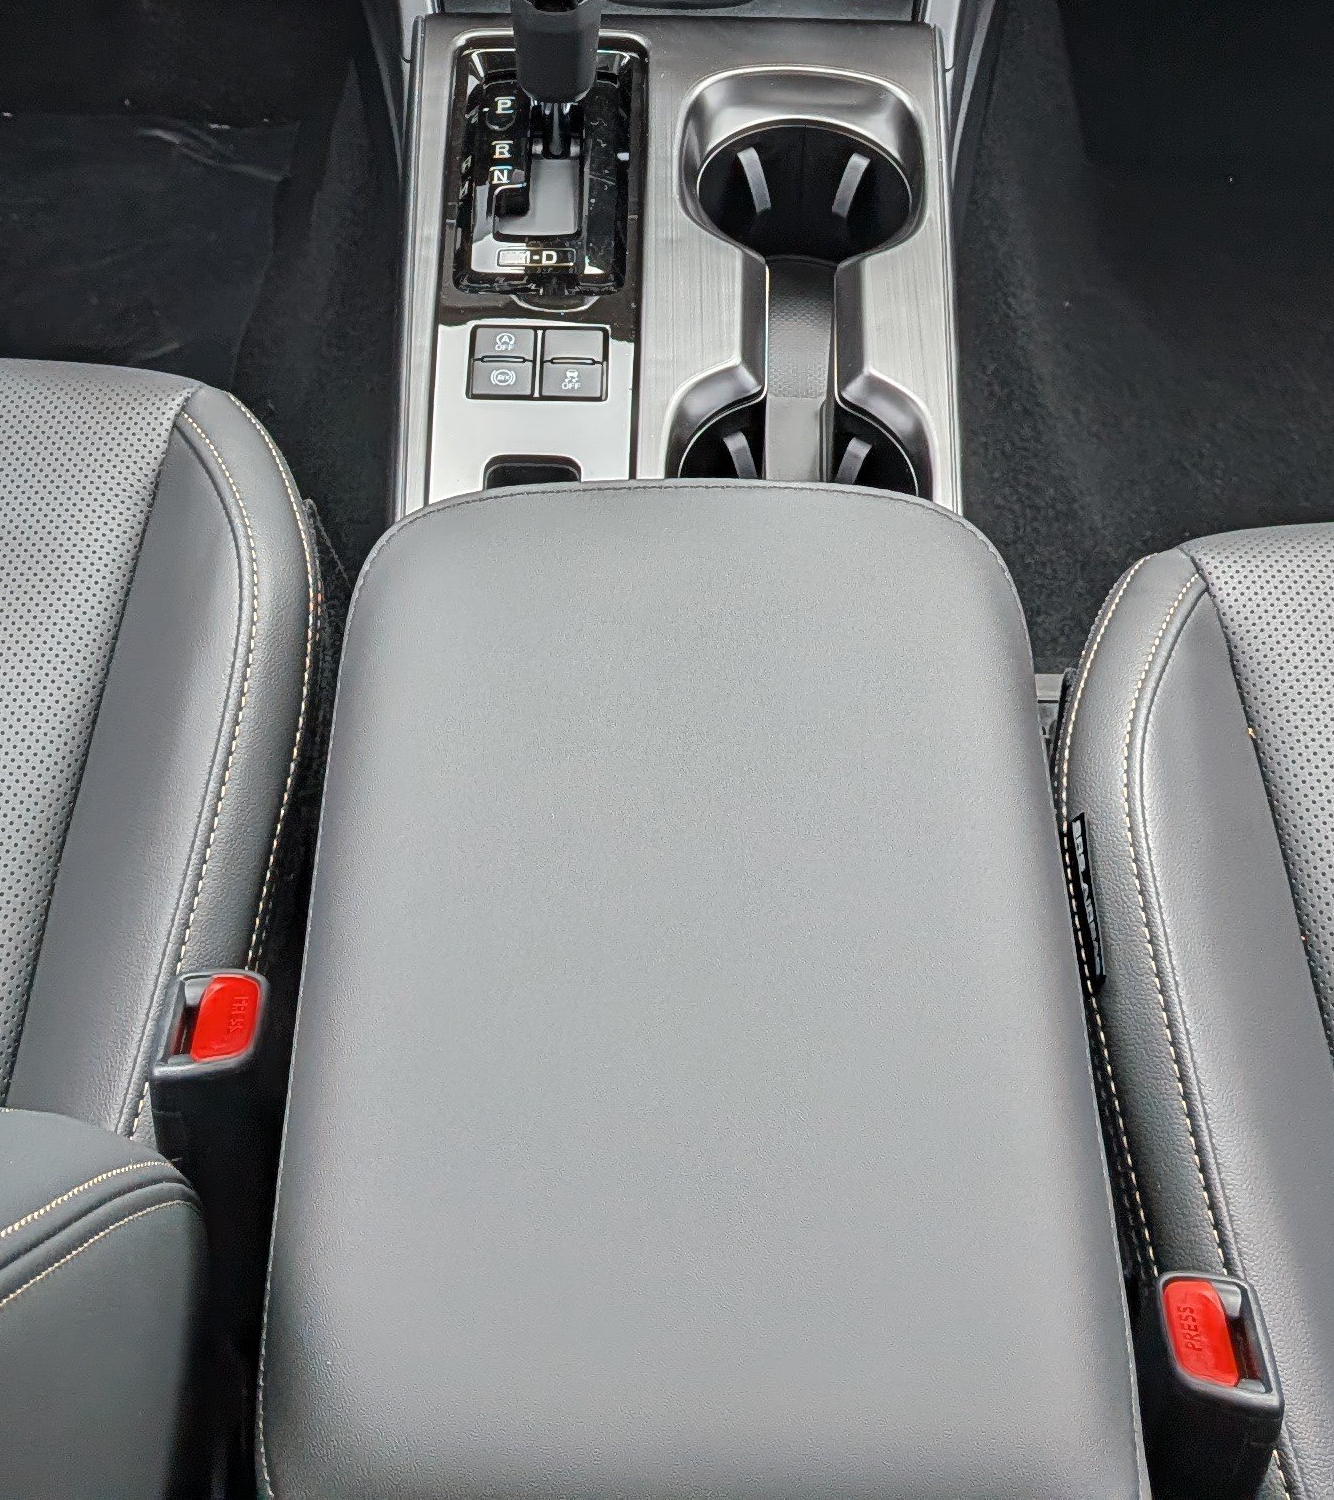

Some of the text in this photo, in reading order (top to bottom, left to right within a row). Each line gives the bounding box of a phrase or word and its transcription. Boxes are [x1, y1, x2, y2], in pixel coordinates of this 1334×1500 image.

[497, 100, 513, 114] P
[495, 144, 512, 159] R
[492, 169, 508, 184] N
[1177, 1305, 1203, 1352] PRESS
